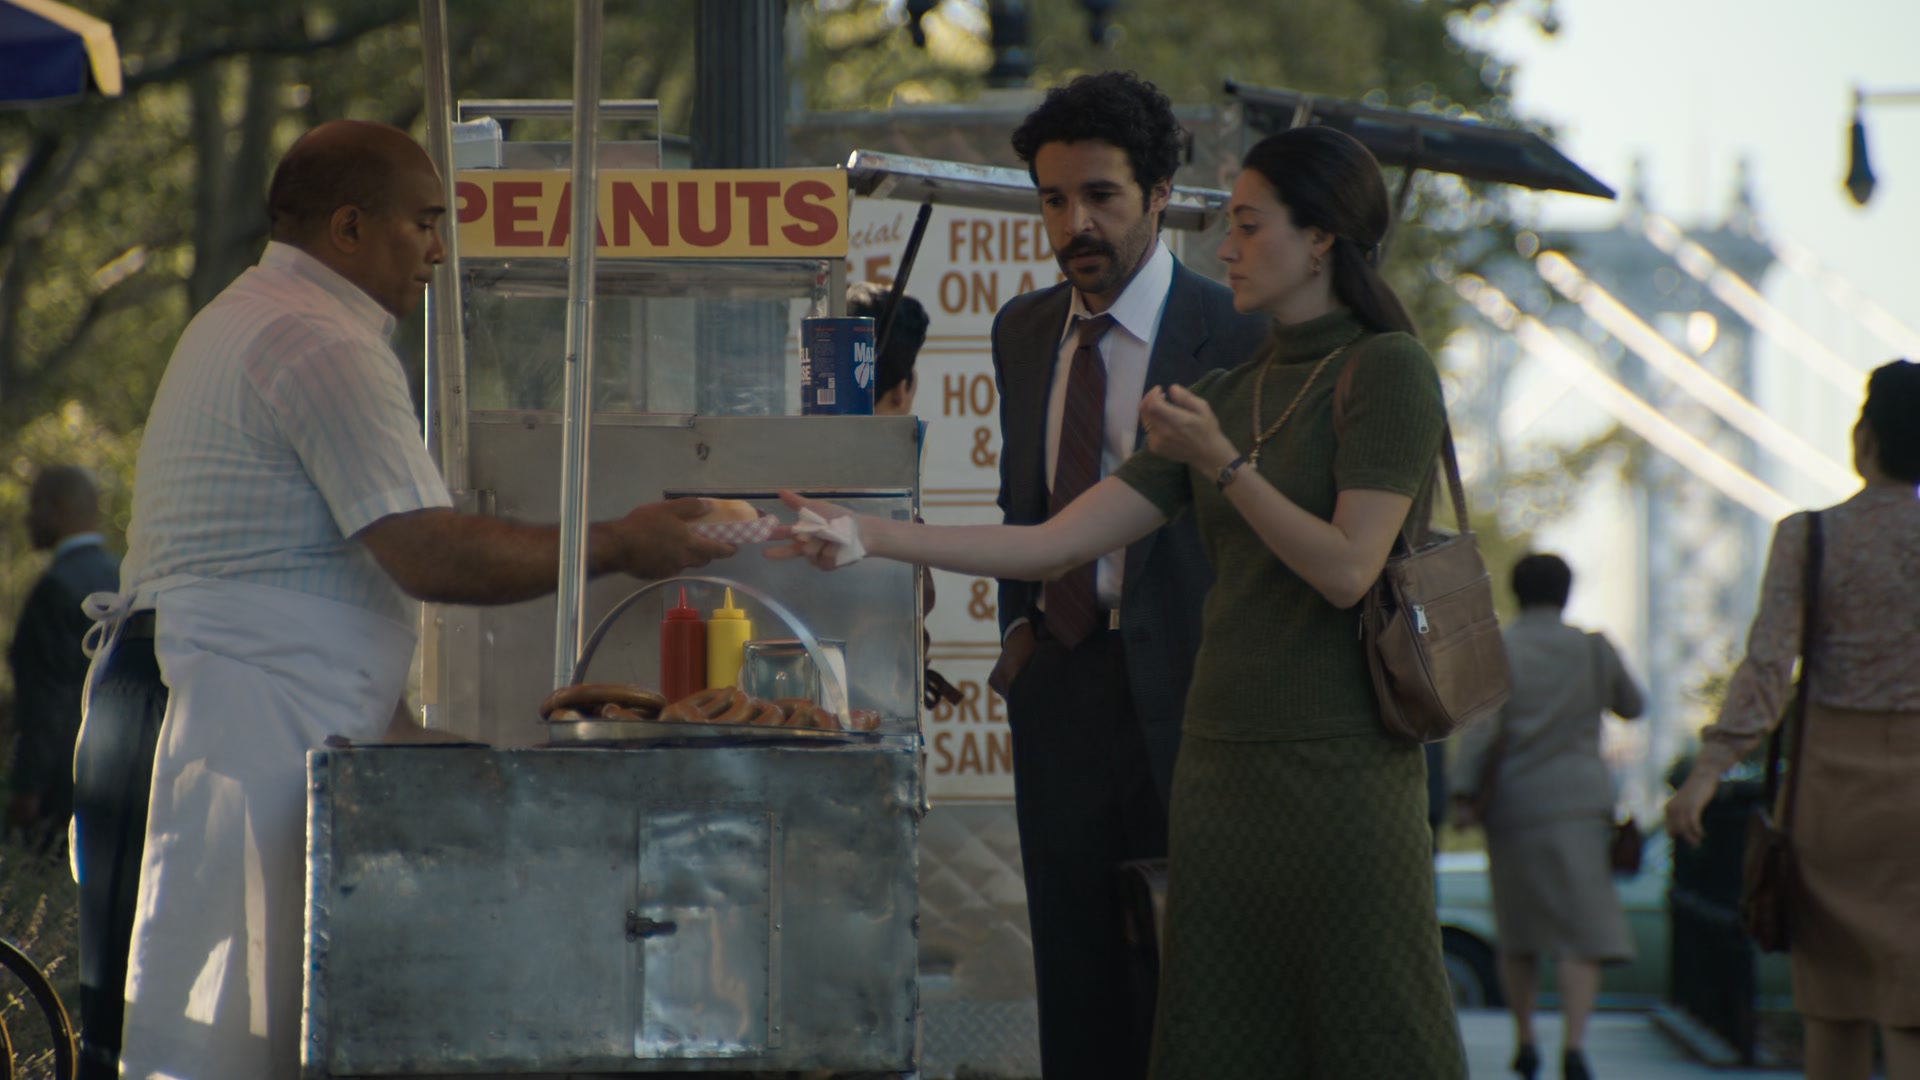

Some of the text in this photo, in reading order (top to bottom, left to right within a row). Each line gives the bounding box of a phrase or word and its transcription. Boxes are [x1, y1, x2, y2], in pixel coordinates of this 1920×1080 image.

[456, 180, 839, 248] PEANUTS
[949, 219, 1054, 262] FRIED
[940, 270, 998, 314] ON
[943, 373, 995, 416] HO
[971, 426, 996, 467] &
[968, 580, 996, 620] &
[933, 680, 1008, 722] BRE
[934, 731, 1012, 774] SAN
